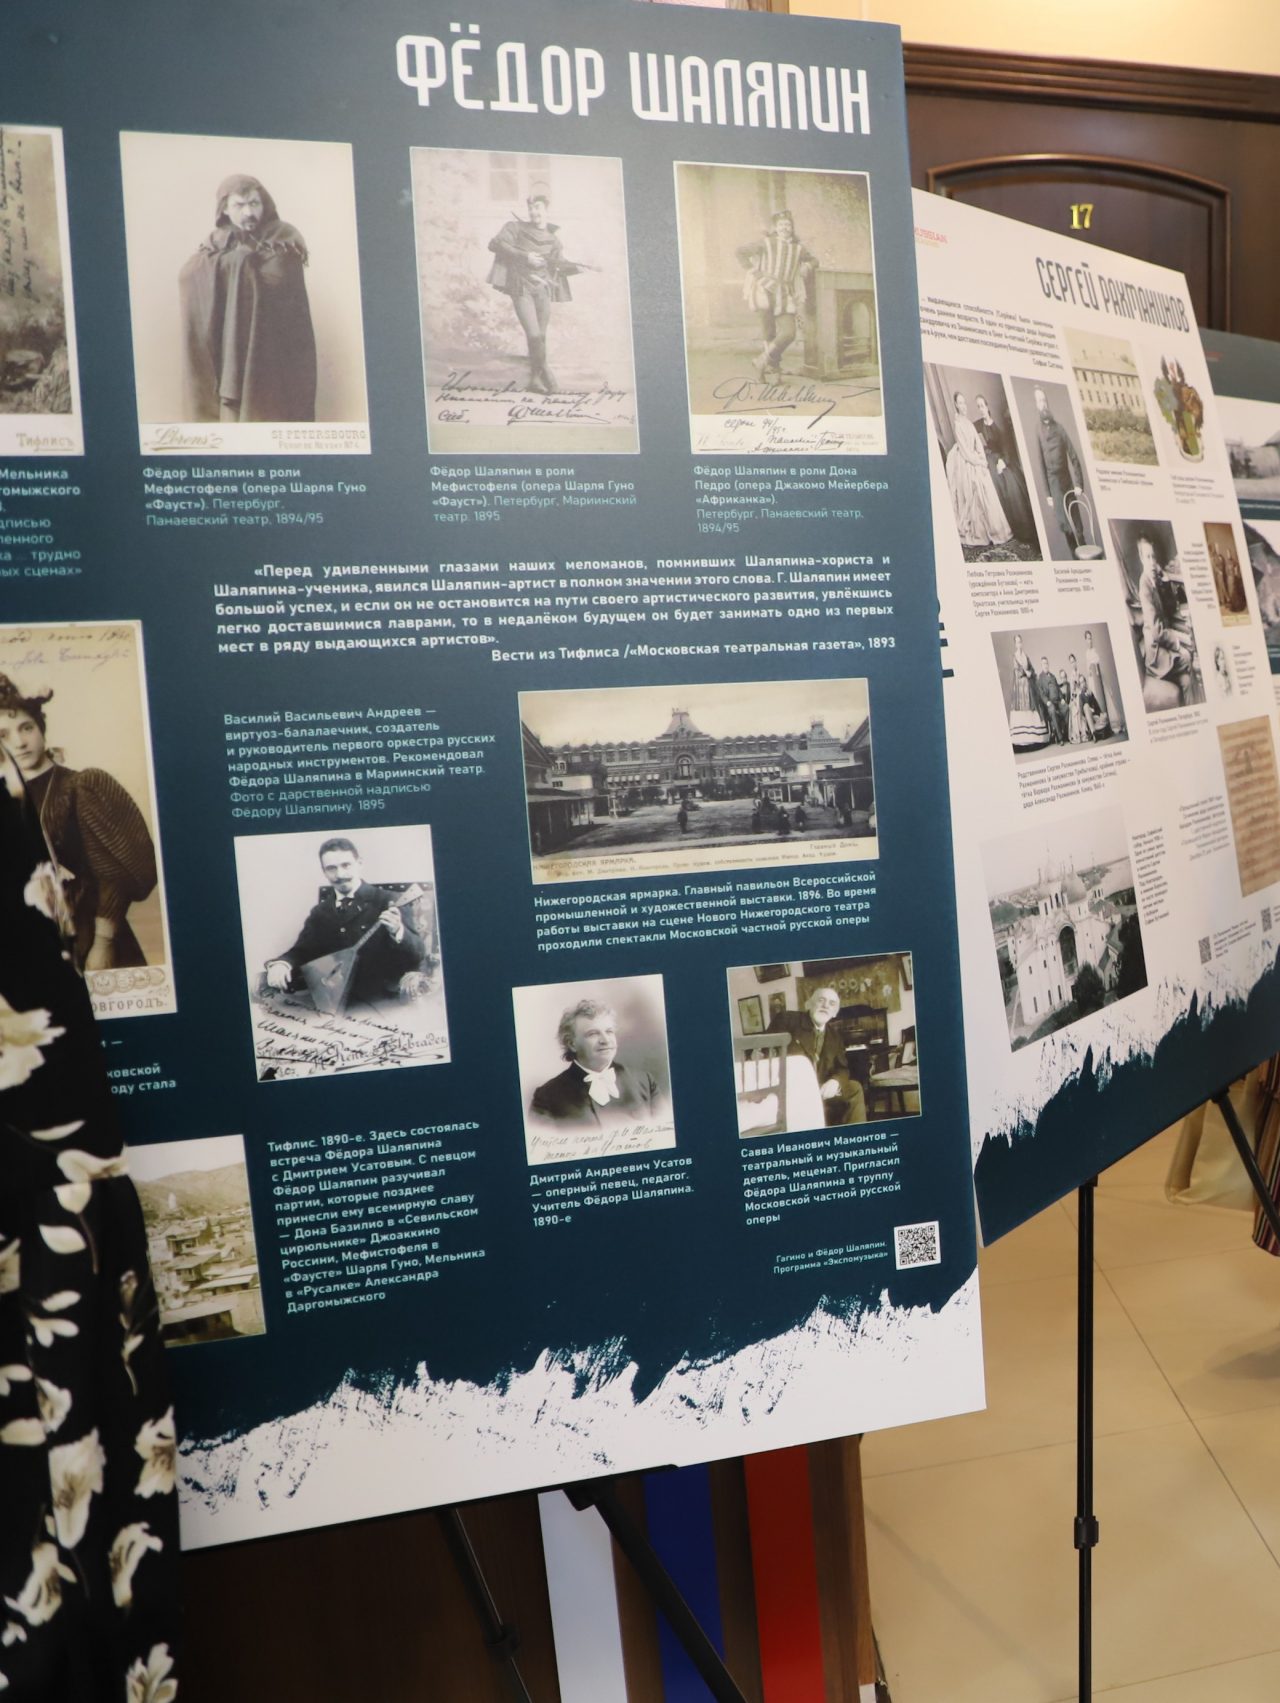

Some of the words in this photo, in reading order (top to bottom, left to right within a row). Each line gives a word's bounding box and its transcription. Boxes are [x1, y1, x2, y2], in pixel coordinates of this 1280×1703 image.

[396, 22, 605, 116] ФЁДОР
[629, 51, 871, 135] ШАЛЯПИН
[1070, 203, 1094, 230] 17
[1035, 257, 1100, 311] СЕРГЕЙ
[1098, 274, 1190, 333] РАХМАНИНОВ
[142, 467, 187, 480] Фёдор
[191, 467, 254, 478] Шаляпин
[257, 469, 265, 477] в
[269, 469, 300, 479] роли
[693, 465, 731, 477] Фёдор
[734, 465, 787, 475] Шаляпин
[789, 467, 796, 475] в
[799, 467, 826, 477] роли
[828, 465, 857, 477] Дона
[144, 483, 238, 496] Мефистофеля
[242, 482, 286, 495] (опера
[290, 482, 334, 495] Шарля
[337, 481, 366, 495] Гуно
[694, 479, 730, 492] Педро
[734, 479, 771, 492] (опера
[774, 479, 825, 491] Джакомо
[828, 479, 888, 492] Мейербера
[562, 494, 636, 507] Мариинский
[146, 513, 228, 526] Панаевский
[275, 512, 323, 524] 1894/95
[473, 510, 500, 521] 1895
[760, 507, 828, 518] Панаевский
[697, 522, 739, 533] 1894/95
[254, 564, 312, 579] «Перед
[322, 564, 428, 578] удивленными
[439, 562, 498, 572] глазами
[508, 561, 555, 571] наших
[656, 558, 735, 568] помнивших
[744, 555, 873, 568] Шаляпина-хориста
[882, 556, 890, 564] и
[215, 600, 285, 615] большой
[340, 602, 350, 612] и
[354, 601, 390, 611] если
[393, 600, 412, 610] он
[416, 600, 434, 609] не
[438, 597, 530, 609] остановится
[534, 597, 551, 606] на
[555, 596, 588, 608] пути
[591, 595, 638, 605] своего
[642, 592, 750, 606] артистического
[821, 589, 892, 602] увлёкшись
[491, 649, 534, 661] Вести
[538, 650, 555, 659] из
[558, 646, 619, 660] Тифлиса
[623, 644, 719, 658] /«Московская
[723, 642, 808, 655] театральная
[868, 636, 895, 648] 1893
[223, 711, 280, 725] Василий
[284, 710, 362, 722] Васильевич
[366, 707, 421, 719] Андреев
[375, 722, 440, 733] создатель
[226, 748, 235, 756] и
[238, 743, 329, 758] руководитель
[332, 740, 383, 752] первого
[386, 737, 443, 750] оркестра
[447, 735, 495, 747] русских
[534, 892, 626, 907] Нижегородская
[684, 881, 732, 895] Главный
[735, 880, 789, 891] павильон
[792, 870, 875, 887] Всероссийской
[537, 938, 602, 953] проходили
[605, 933, 666, 945] спектакли
[669, 923, 738, 939] Московской
[740, 919, 786, 933] частной
[789, 915, 832, 932] русской
[835, 915, 869, 926] оперы
[138, 1079, 177, 1091] стала
[369, 1129, 407, 1141] Здесь
[410, 1121, 479, 1136] состоялась
[270, 1153, 321, 1167] встреча
[324, 1147, 374, 1160] Фёдора
[377, 1139, 442, 1154] Шаляпина
[740, 1147, 774, 1158] Савва
[777, 1140, 830, 1153] Иванович
[833, 1132, 886, 1146] Мамонтов
[529, 1168, 581, 1186] Дмитрий
[585, 1163, 650, 1178] Андреевич
[652, 1157, 692, 1169] Усатов
[843, 1157, 900, 1172] Пригласил
[545, 1181, 597, 1197] оперный
[743, 1186, 786, 1198] Фёдора
[789, 1178, 845, 1192] Шаляпина
[857, 1172, 898, 1184] труппу
[532, 1200, 581, 1213] Учитель
[583, 1193, 628, 1205] Фёдора
[744, 1193, 810, 1212] Московской
[813, 1187, 856, 1202] частной
[859, 1181, 900, 1198] русской
[276, 1211, 338, 1227] принесли
[341, 1208, 364, 1218] ему
[367, 1198, 437, 1214] всемирную
[440, 1194, 474, 1205] славу
[533, 1214, 571, 1227] 1890-е
[280, 1237, 366, 1255] цирюльнике»
[370, 1227, 440, 1245] Джоаккино
[287, 1291, 385, 1314] Даргомыжского
